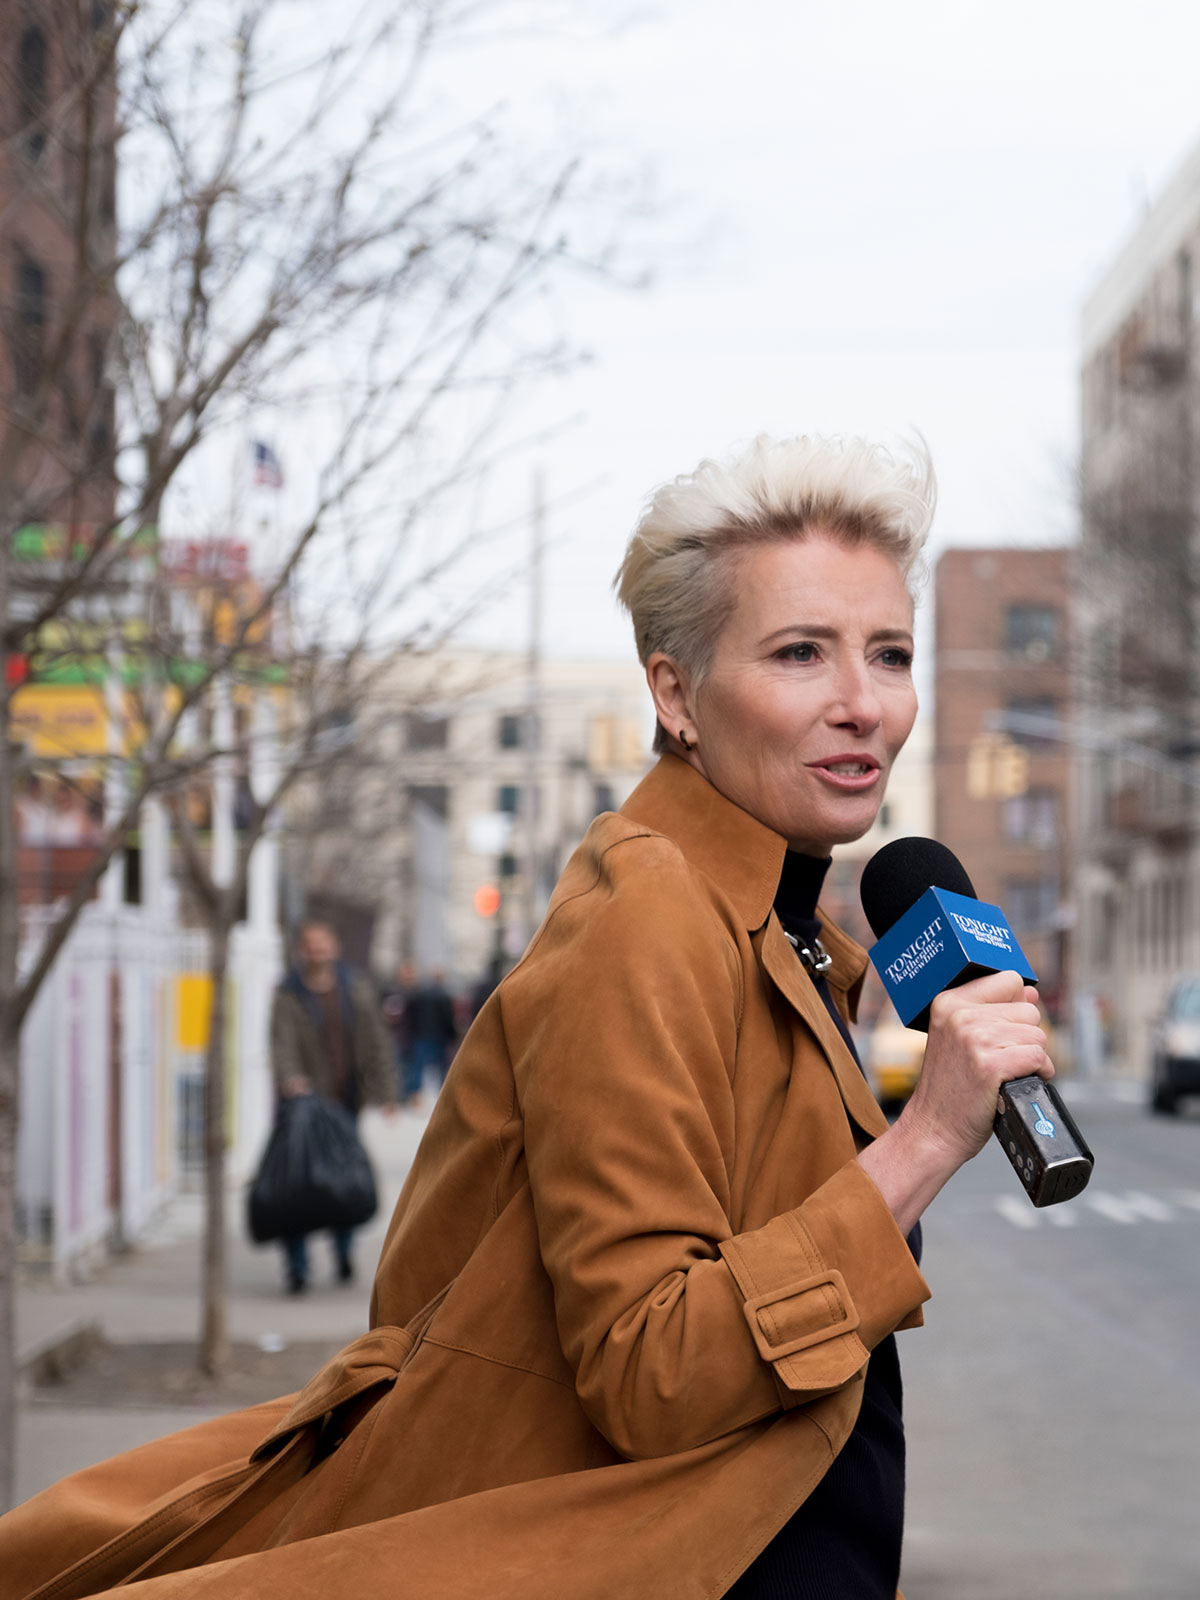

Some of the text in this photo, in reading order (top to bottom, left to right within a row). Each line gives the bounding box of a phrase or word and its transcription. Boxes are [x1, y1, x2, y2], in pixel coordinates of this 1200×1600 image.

[950, 911, 1010, 940] TONIGHT
[885, 916, 942, 979] TONIGHT
[908, 940, 945, 979] newbury
